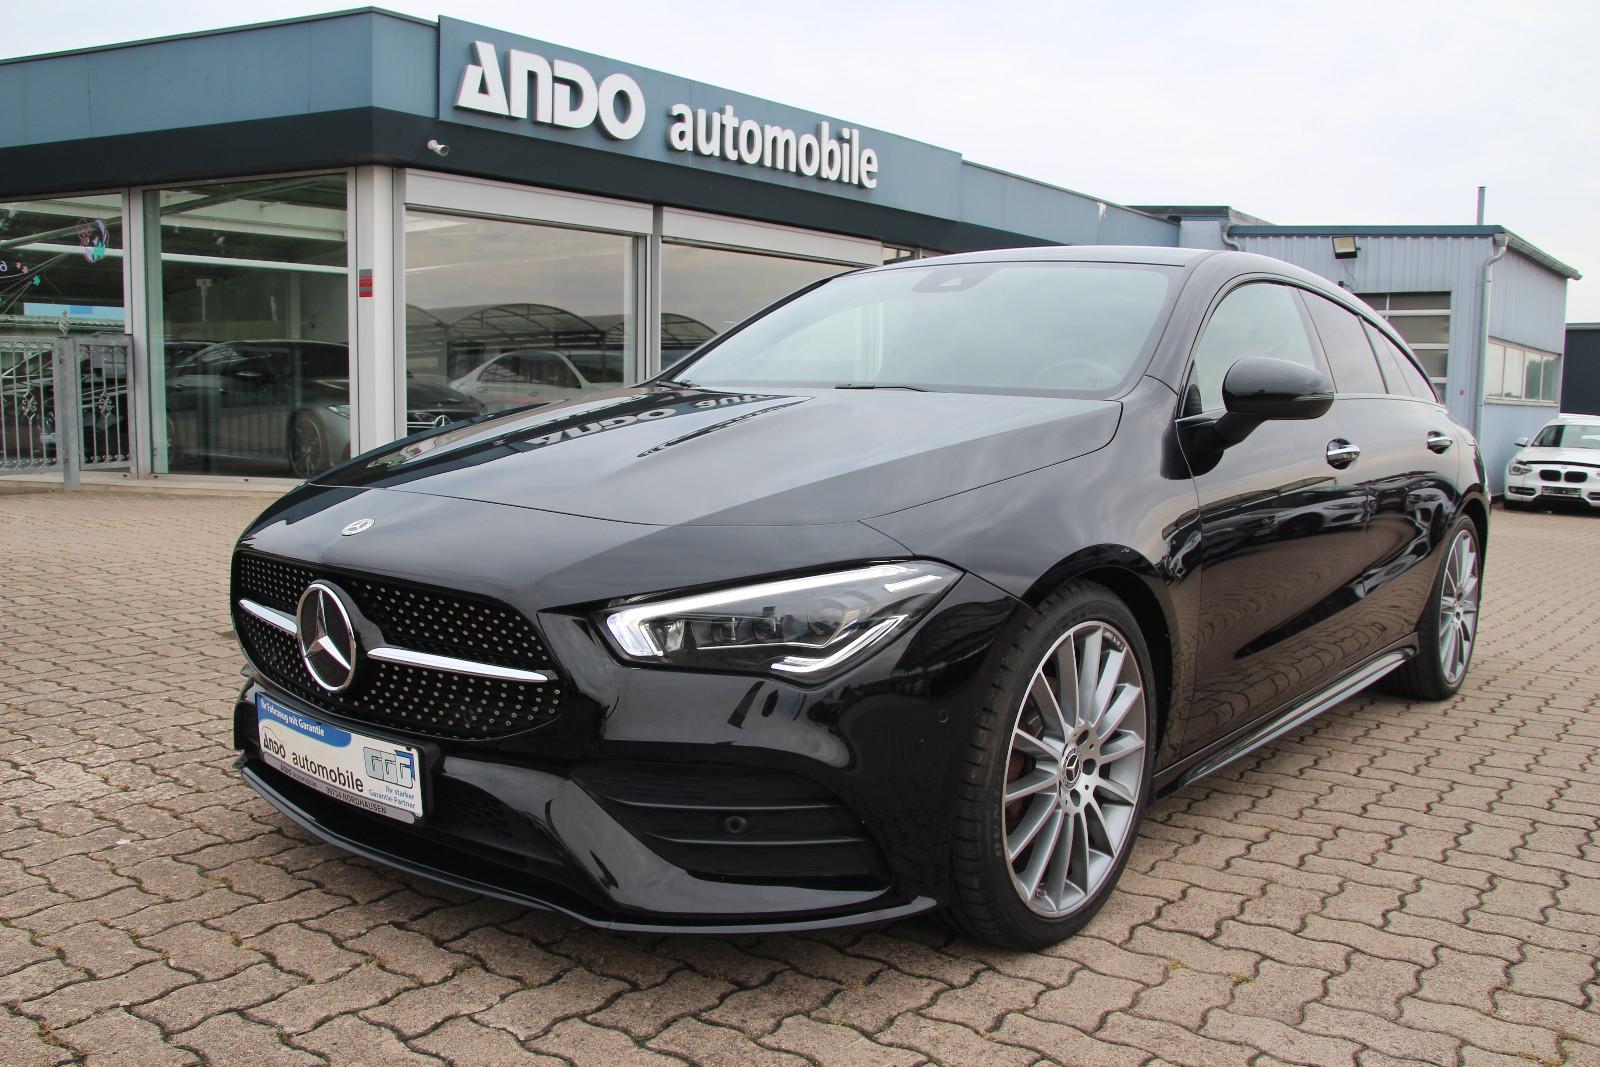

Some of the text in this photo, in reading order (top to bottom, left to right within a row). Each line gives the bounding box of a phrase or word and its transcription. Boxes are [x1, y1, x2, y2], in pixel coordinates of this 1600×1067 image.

[455, 40, 879, 189] ANDO automobile
[288, 716, 298, 726] mit
[298, 719, 325, 737] Garantie
[292, 752, 364, 793] automobile
[343, 791, 387, 814] NORDHAUSEN
